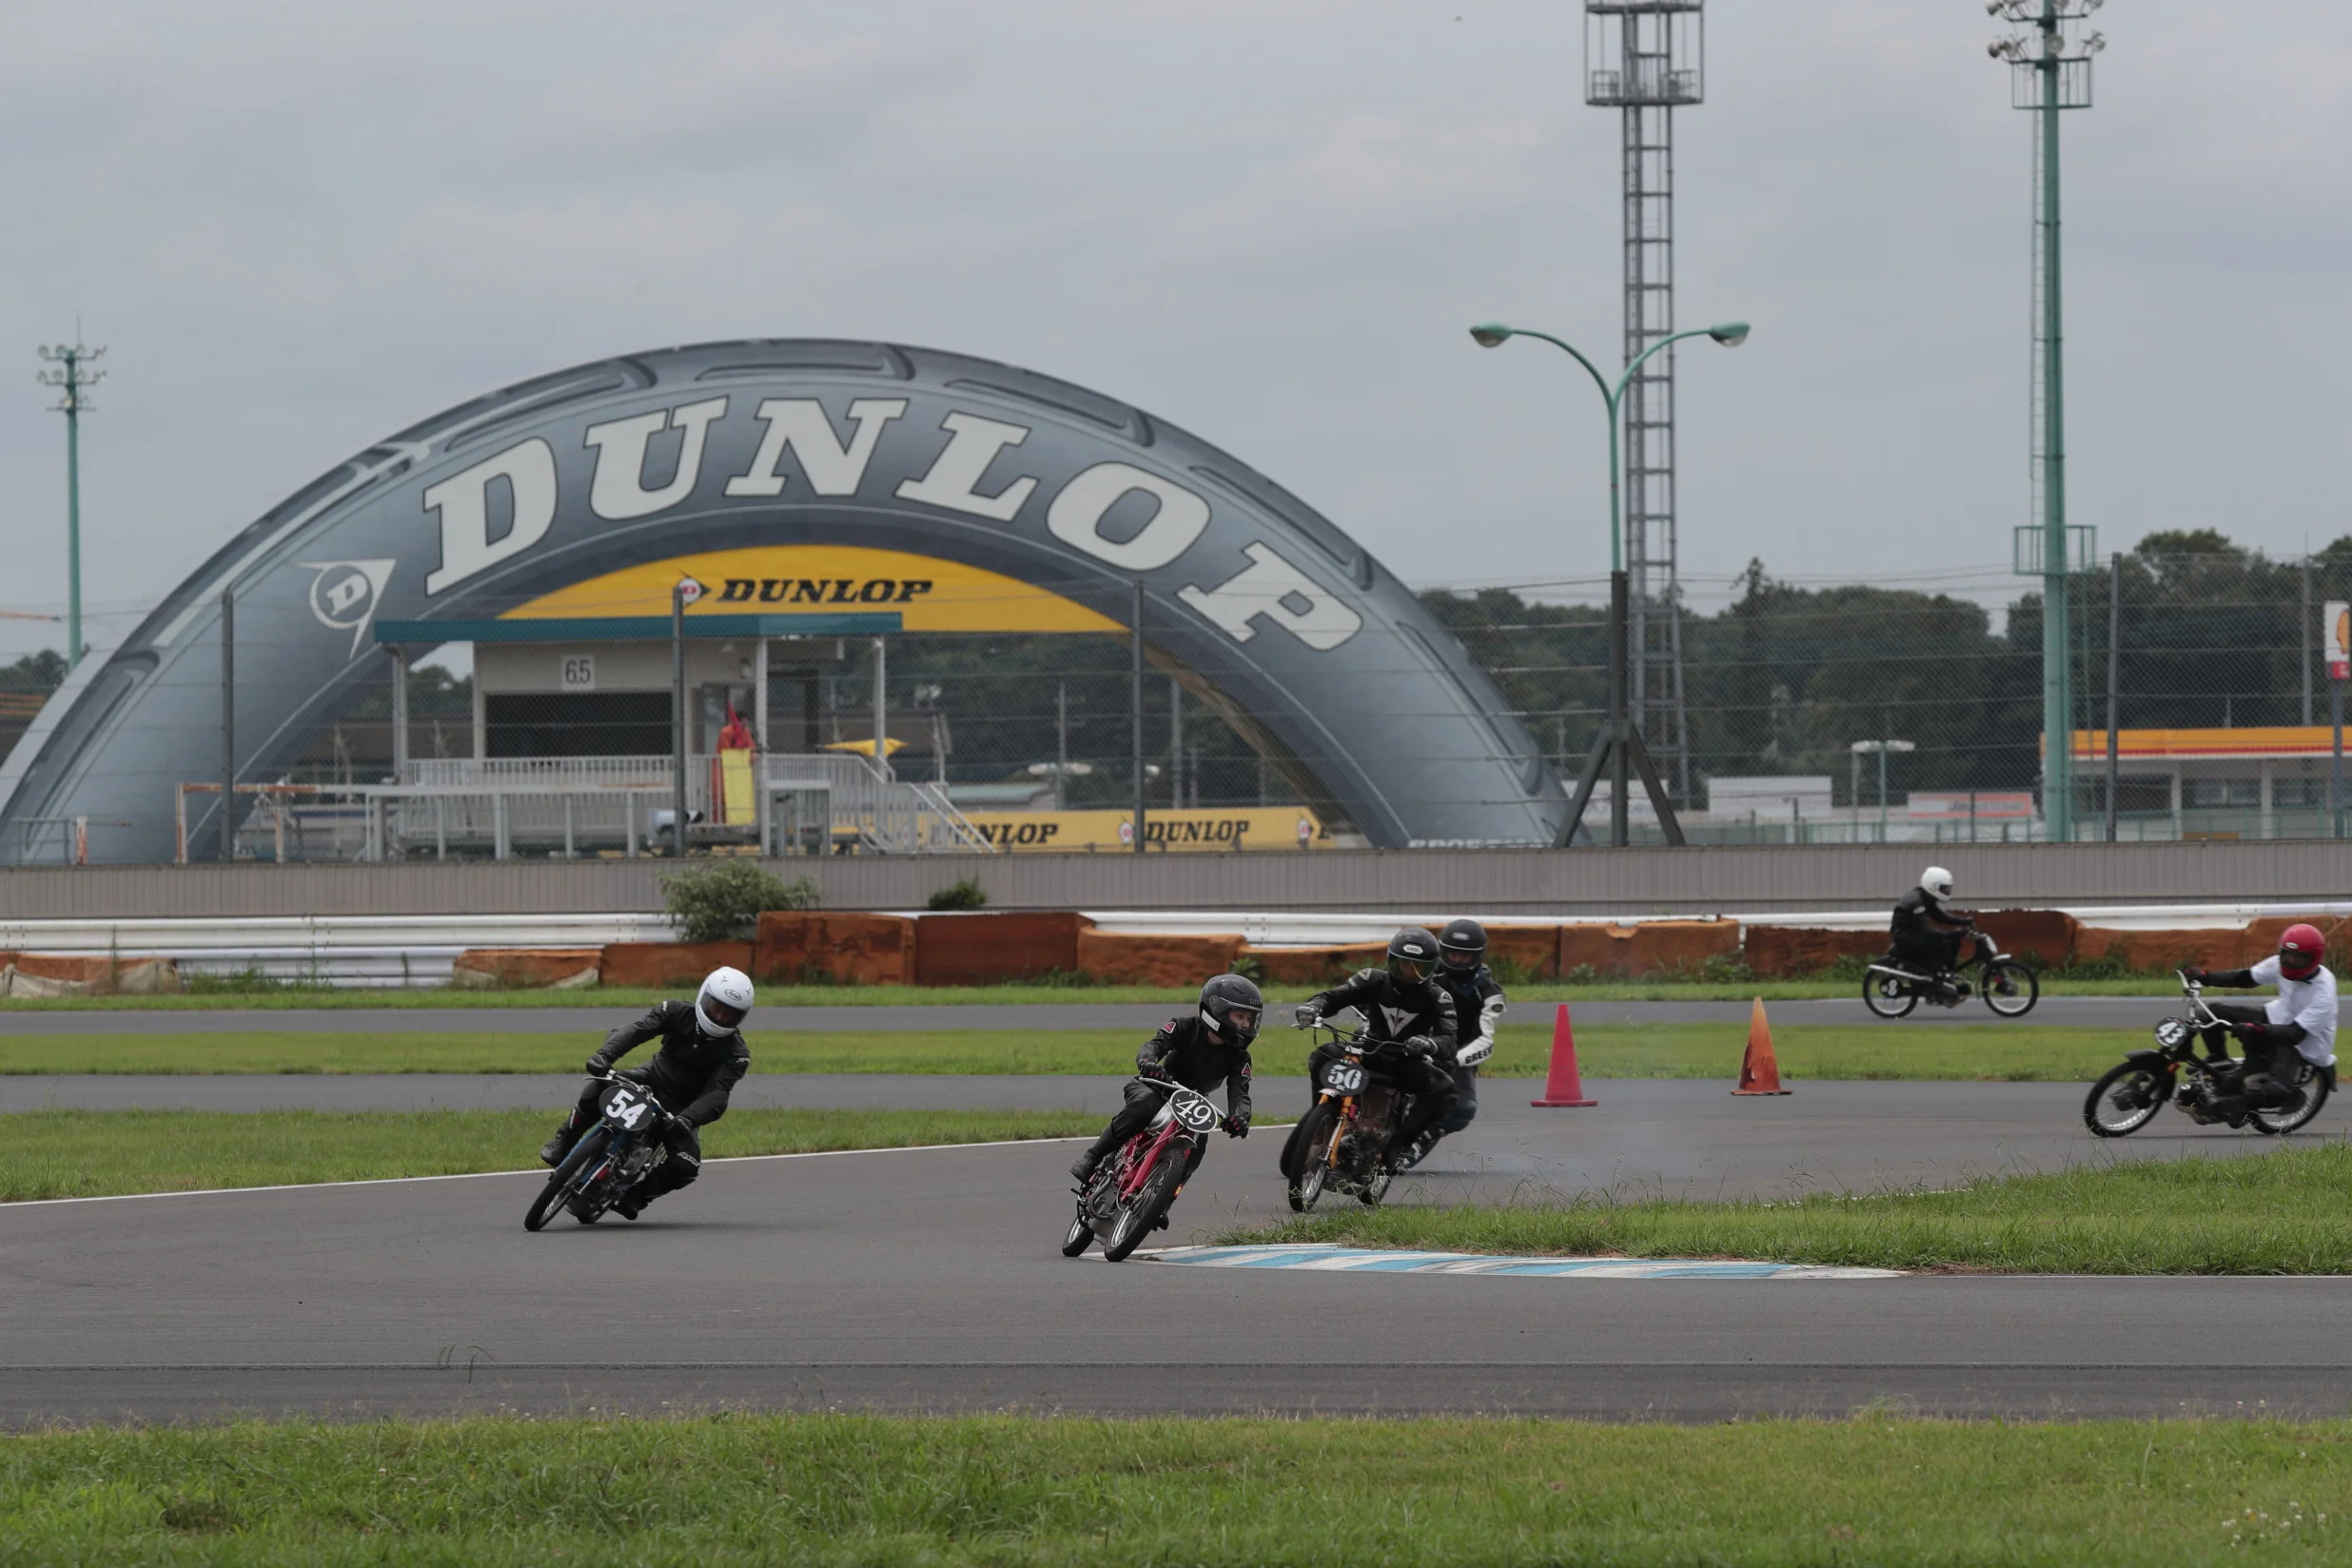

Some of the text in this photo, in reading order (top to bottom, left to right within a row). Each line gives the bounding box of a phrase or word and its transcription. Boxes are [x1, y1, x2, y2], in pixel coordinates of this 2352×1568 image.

[422, 395, 1363, 651] DUNLOP
[715, 578, 932, 602] DUNLOP
[565, 658, 591, 684] 65
[929, 823, 1058, 844] NLOP
[1145, 820, 1248, 842] DUNLOP
[2158, 1021, 2183, 1044] 43
[605, 1088, 647, 1128] 54
[1175, 1099, 1212, 1126] 49
